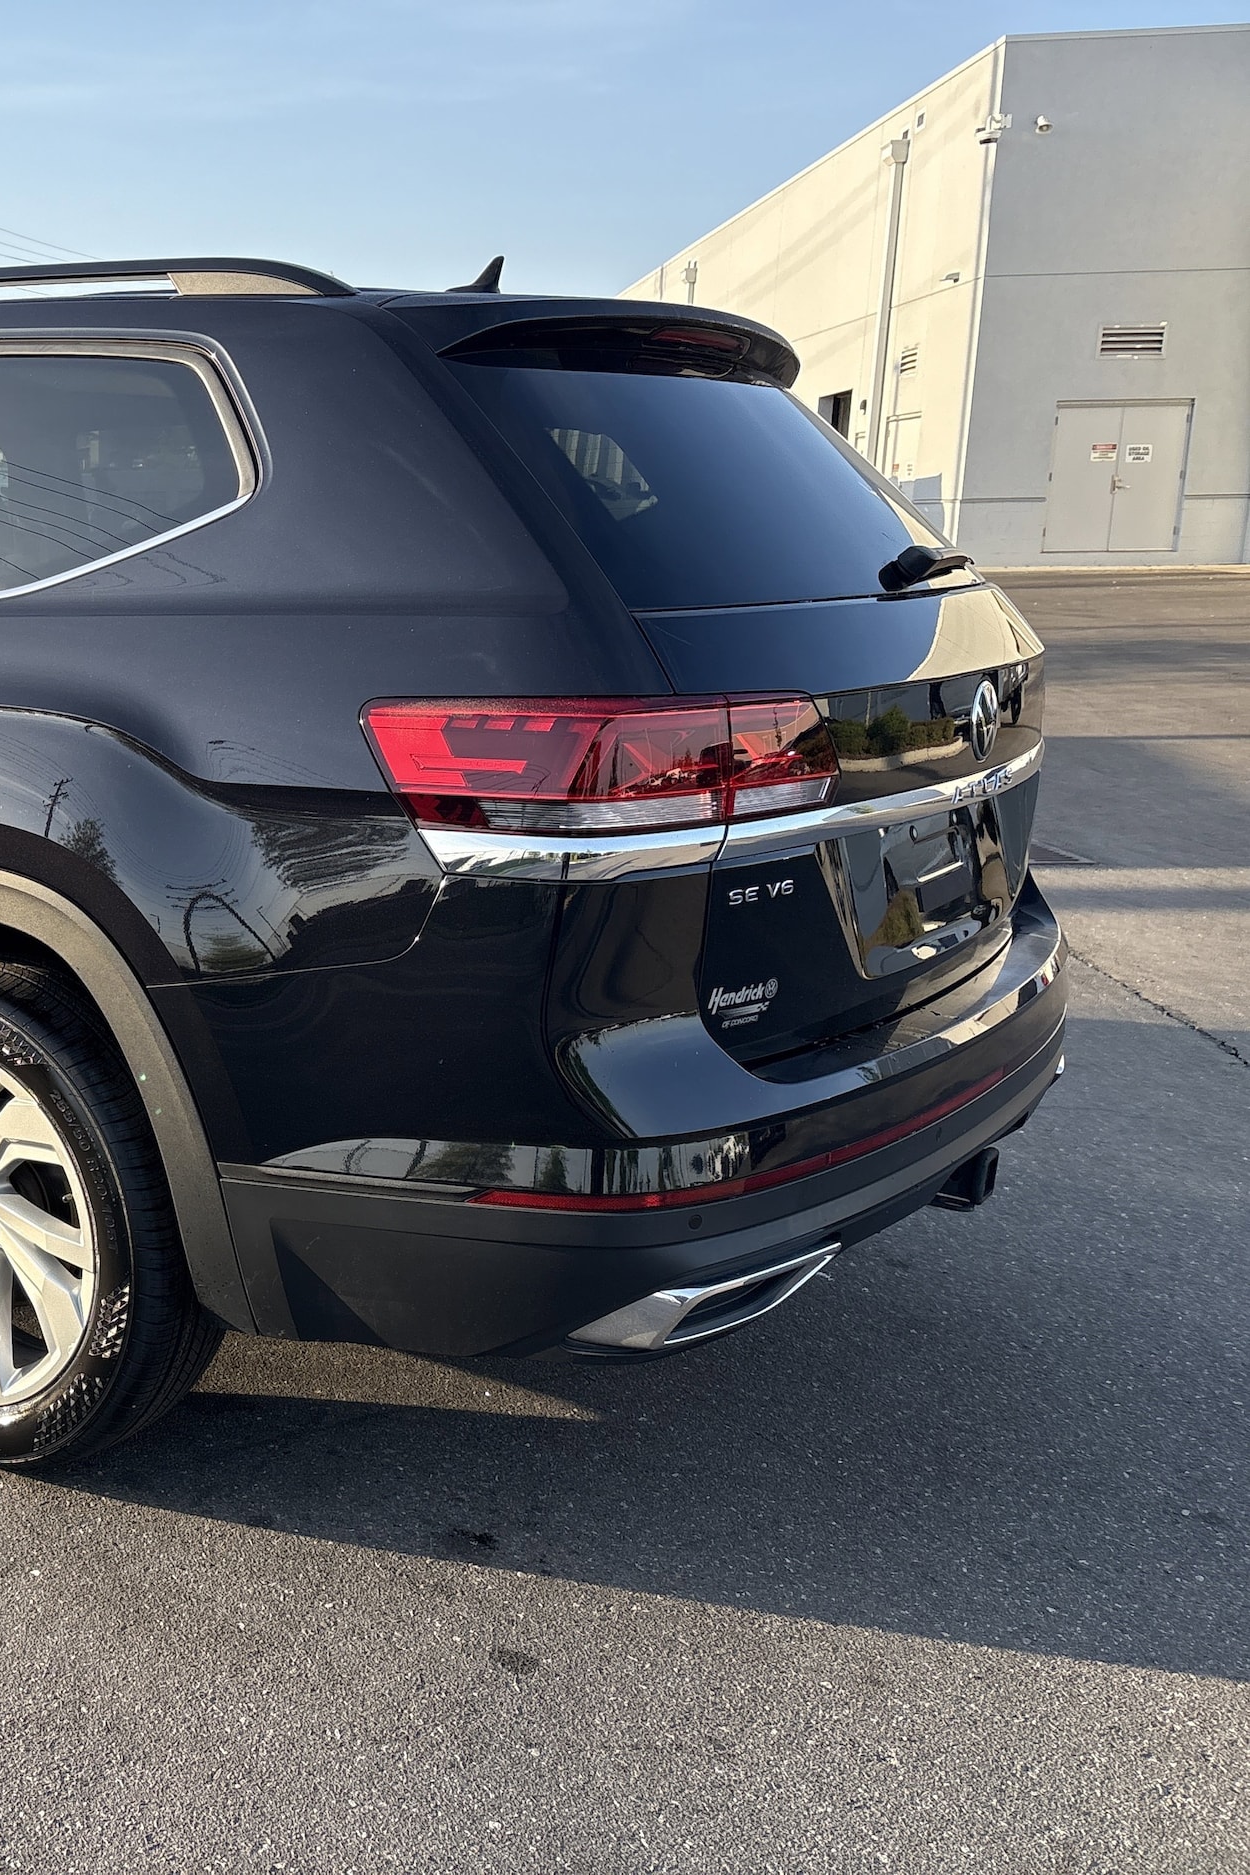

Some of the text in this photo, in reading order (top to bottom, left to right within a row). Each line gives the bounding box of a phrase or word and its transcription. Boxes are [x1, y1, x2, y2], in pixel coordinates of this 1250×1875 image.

[951, 767, 1013, 804] ATLAS
[729, 880, 794, 905] SE V6
[707, 982, 765, 1015] Hendrick
[721, 1015, 759, 1029] OF CONCORD
